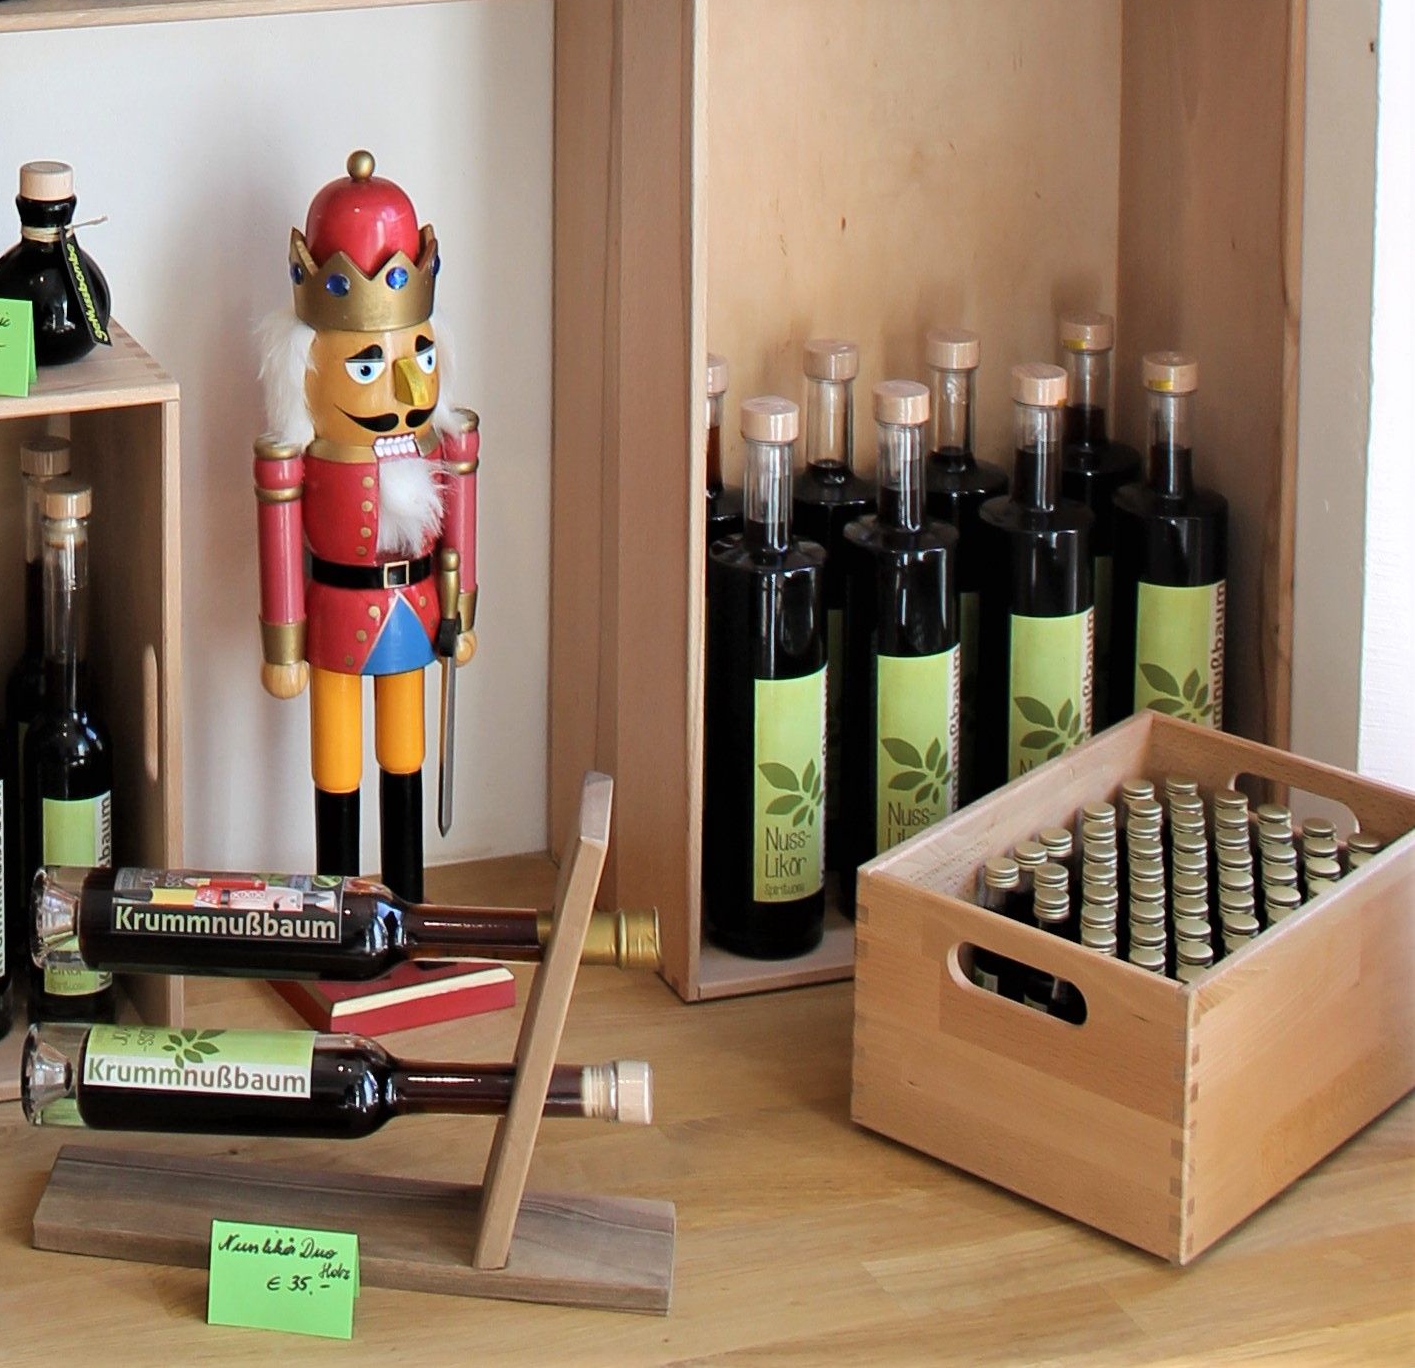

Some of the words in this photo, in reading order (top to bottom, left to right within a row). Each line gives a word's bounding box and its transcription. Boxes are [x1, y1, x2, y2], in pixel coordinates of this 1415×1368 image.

[888, 802, 936, 827] Nuss-
[765, 827, 812, 852] Nuss-
[764, 854, 807, 879] Likör
[116, 905, 336, 940] Krummnußbaum
[89, 1058, 306, 1093] Krummnußbaum
[267, 1276, 281, 1291] €
